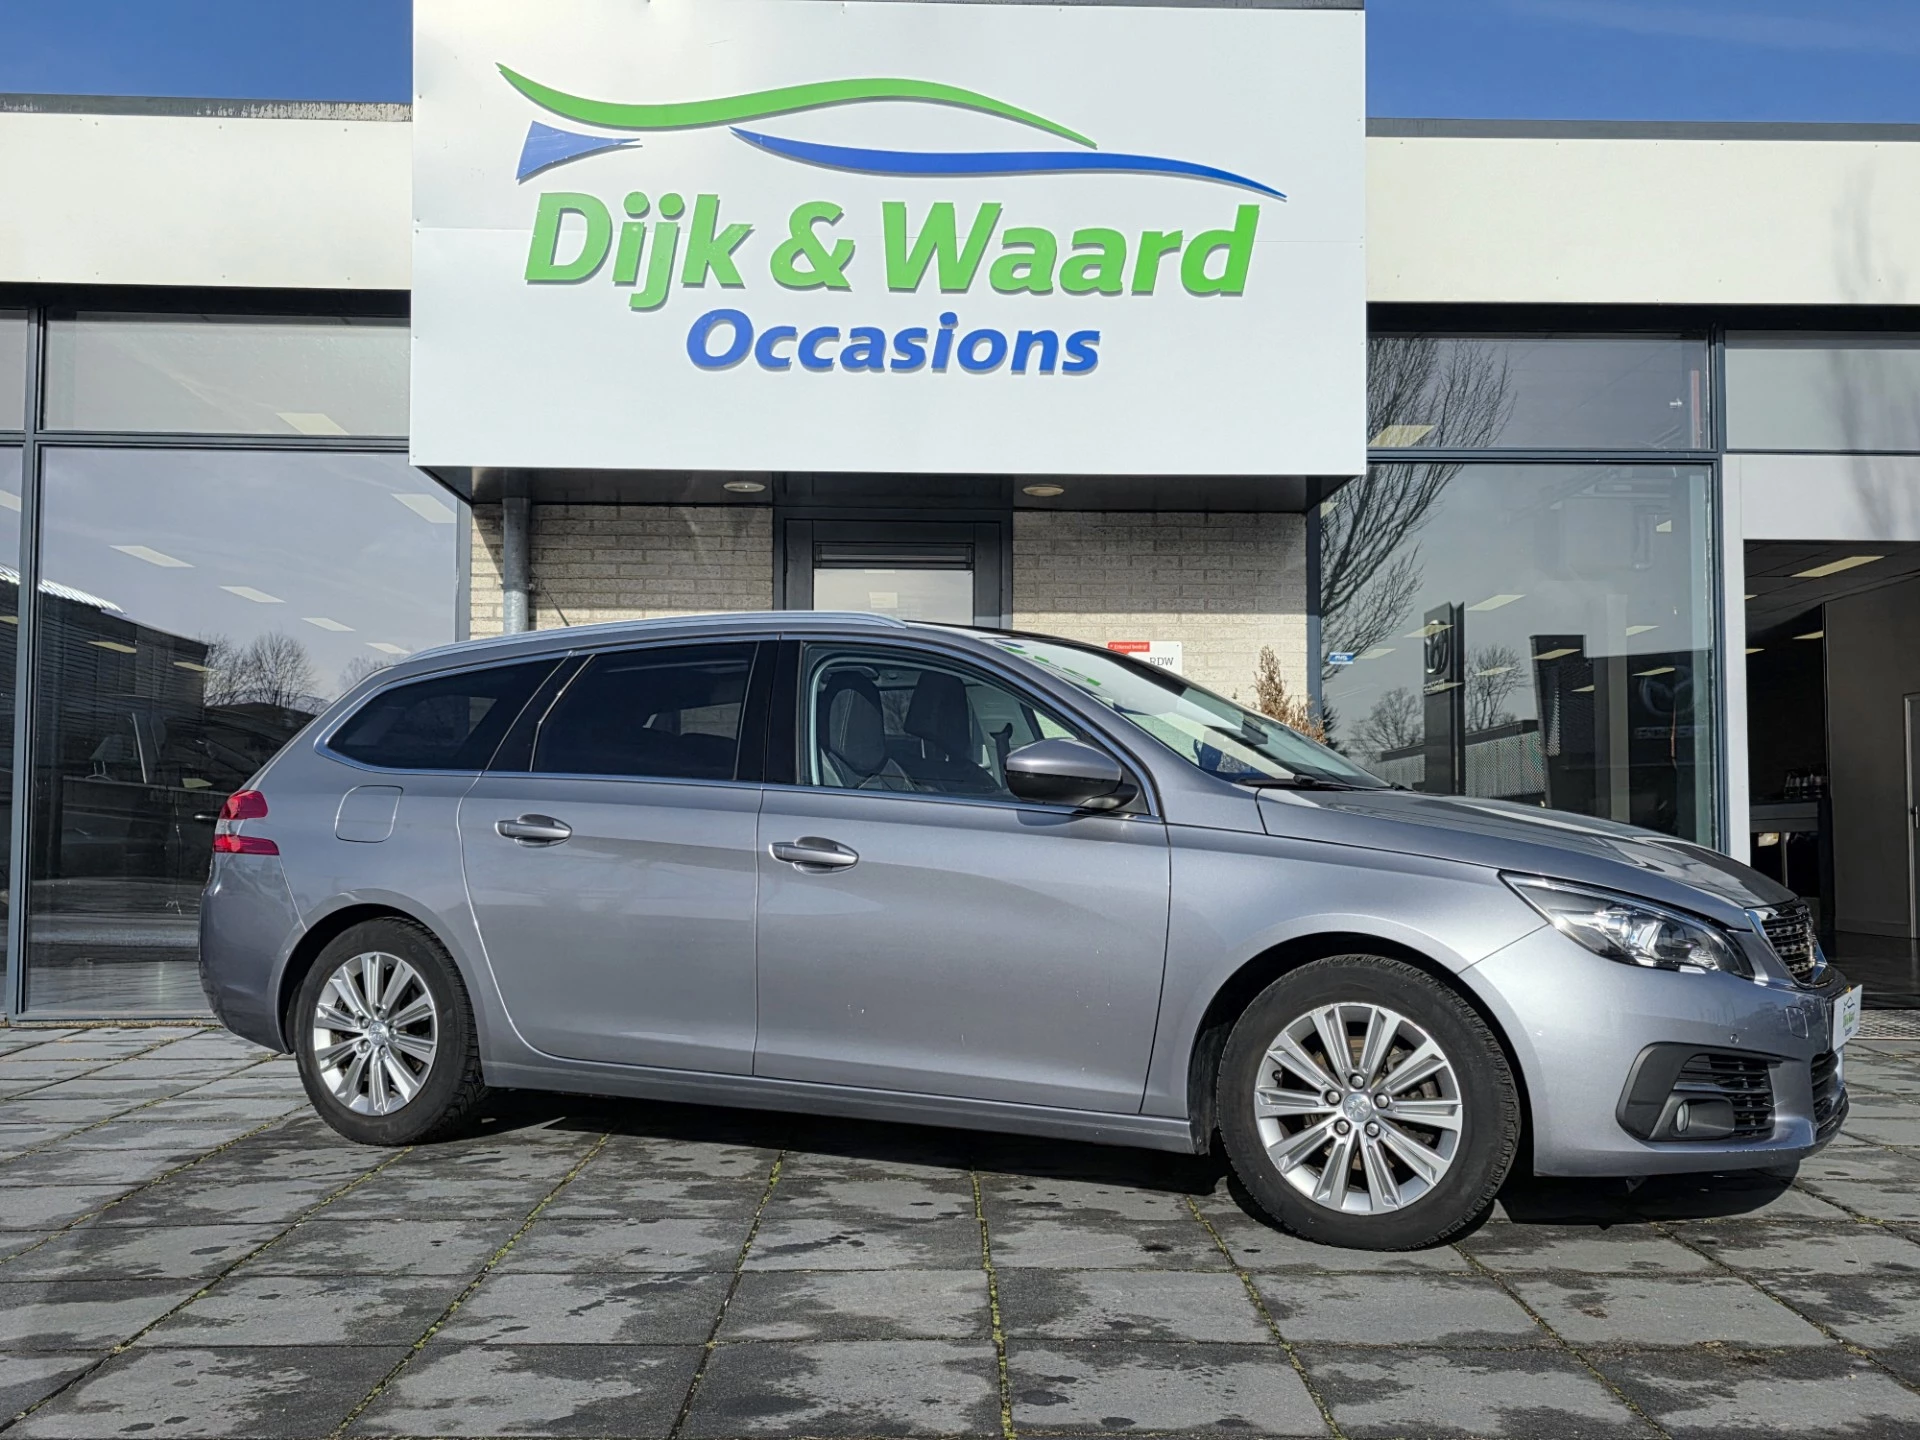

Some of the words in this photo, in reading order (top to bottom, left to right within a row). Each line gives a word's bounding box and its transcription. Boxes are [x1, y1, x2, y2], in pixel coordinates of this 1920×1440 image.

[525, 192, 754, 310] Dijk
[770, 202, 855, 288] &
[882, 202, 1260, 295] Waard
[686, 309, 1101, 374] Occasions
[1149, 656, 1174, 666] RDW
